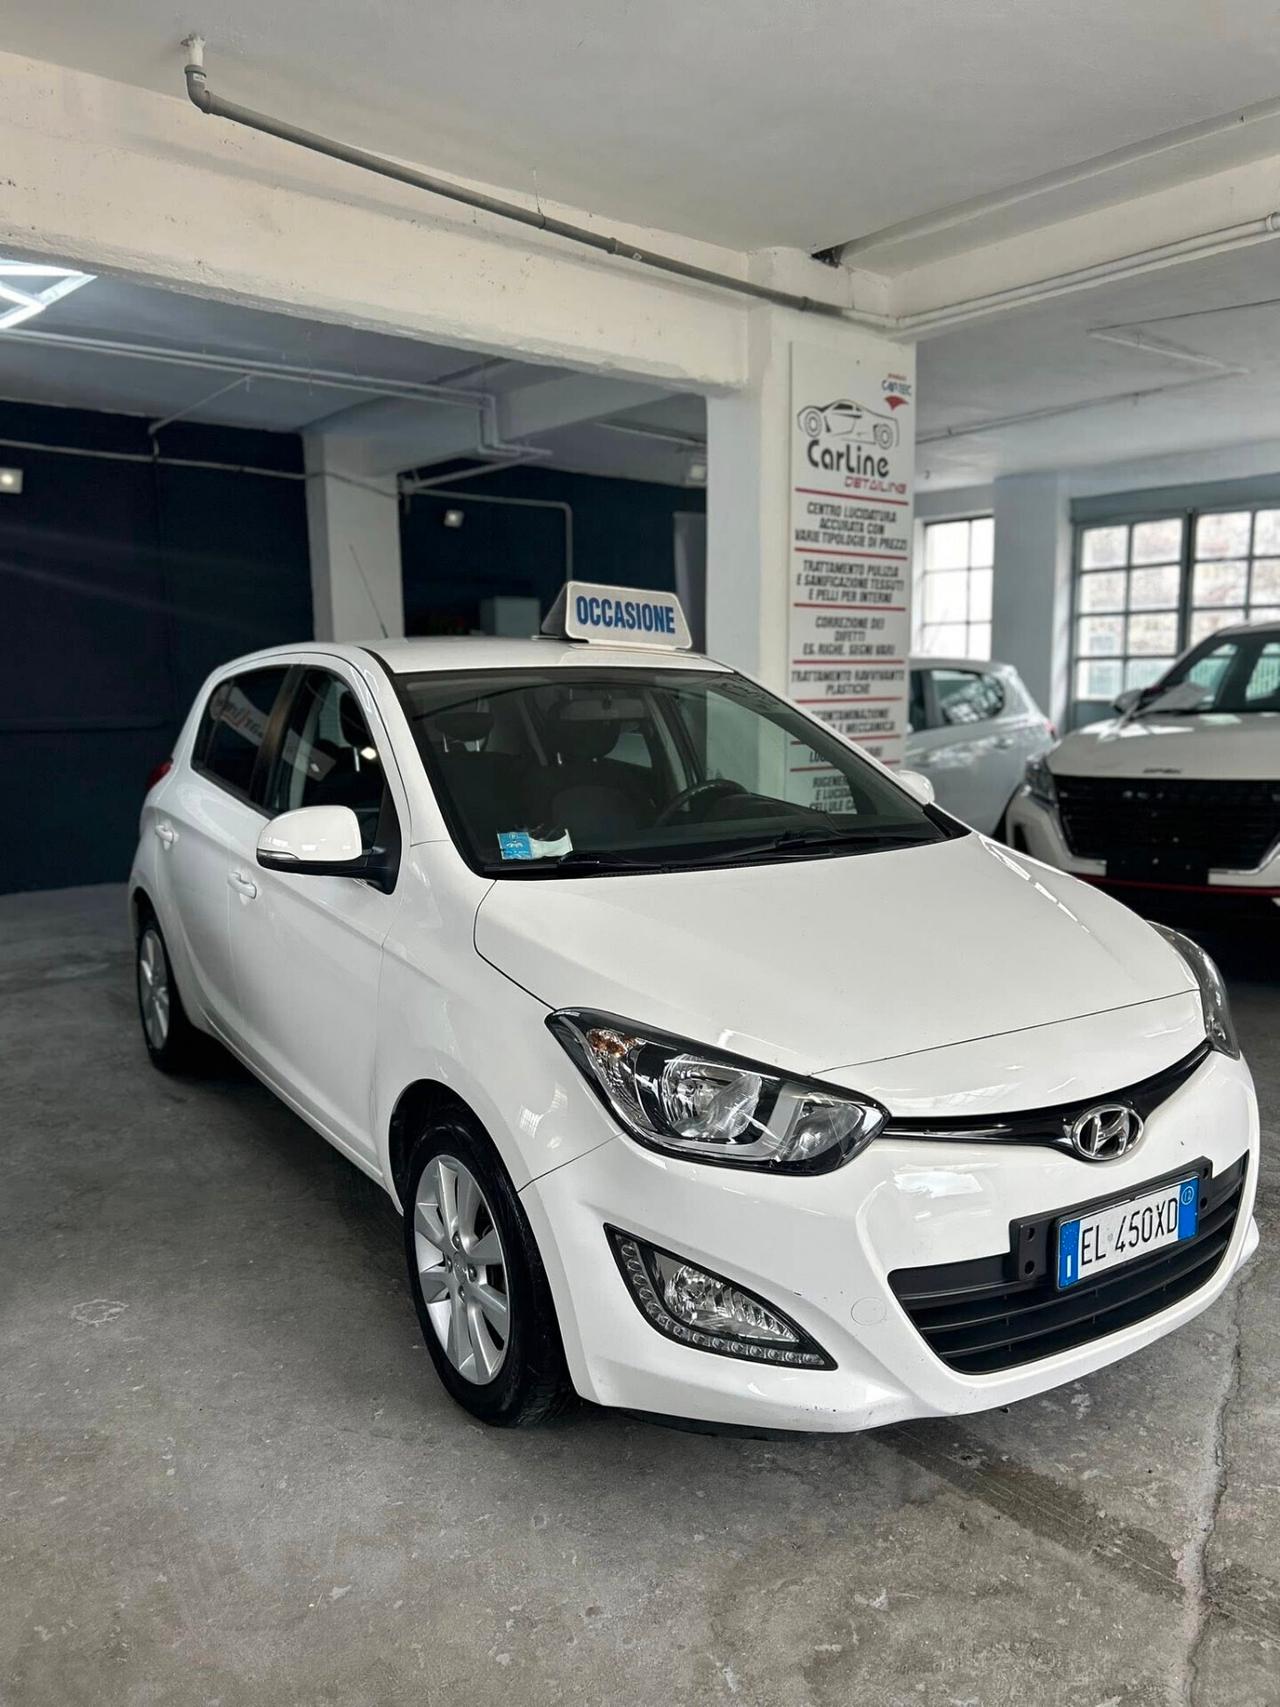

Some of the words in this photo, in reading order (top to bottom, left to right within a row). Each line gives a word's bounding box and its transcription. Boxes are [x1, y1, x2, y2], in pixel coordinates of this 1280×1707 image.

[807, 439, 889, 478] CarLine
[807, 501, 841, 517] CENTRO
[843, 506, 896, 523] LUCIDATURA
[795, 529, 820, 543] VARIE
[822, 532, 865, 547] TIPOLOGIE
[868, 535, 877, 548] DI
[803, 560, 864, 575] TRATTAMENTO
[841, 590, 857, 602] PER
[576, 595, 675, 634] OCCASIONE
[791, 669, 852, 683] TRATTAMENTO
[825, 683, 871, 695] PLASTICHE
[1081, 1224, 1106, 1266] EL
[1115, 1198, 1178, 1253] 450XD
